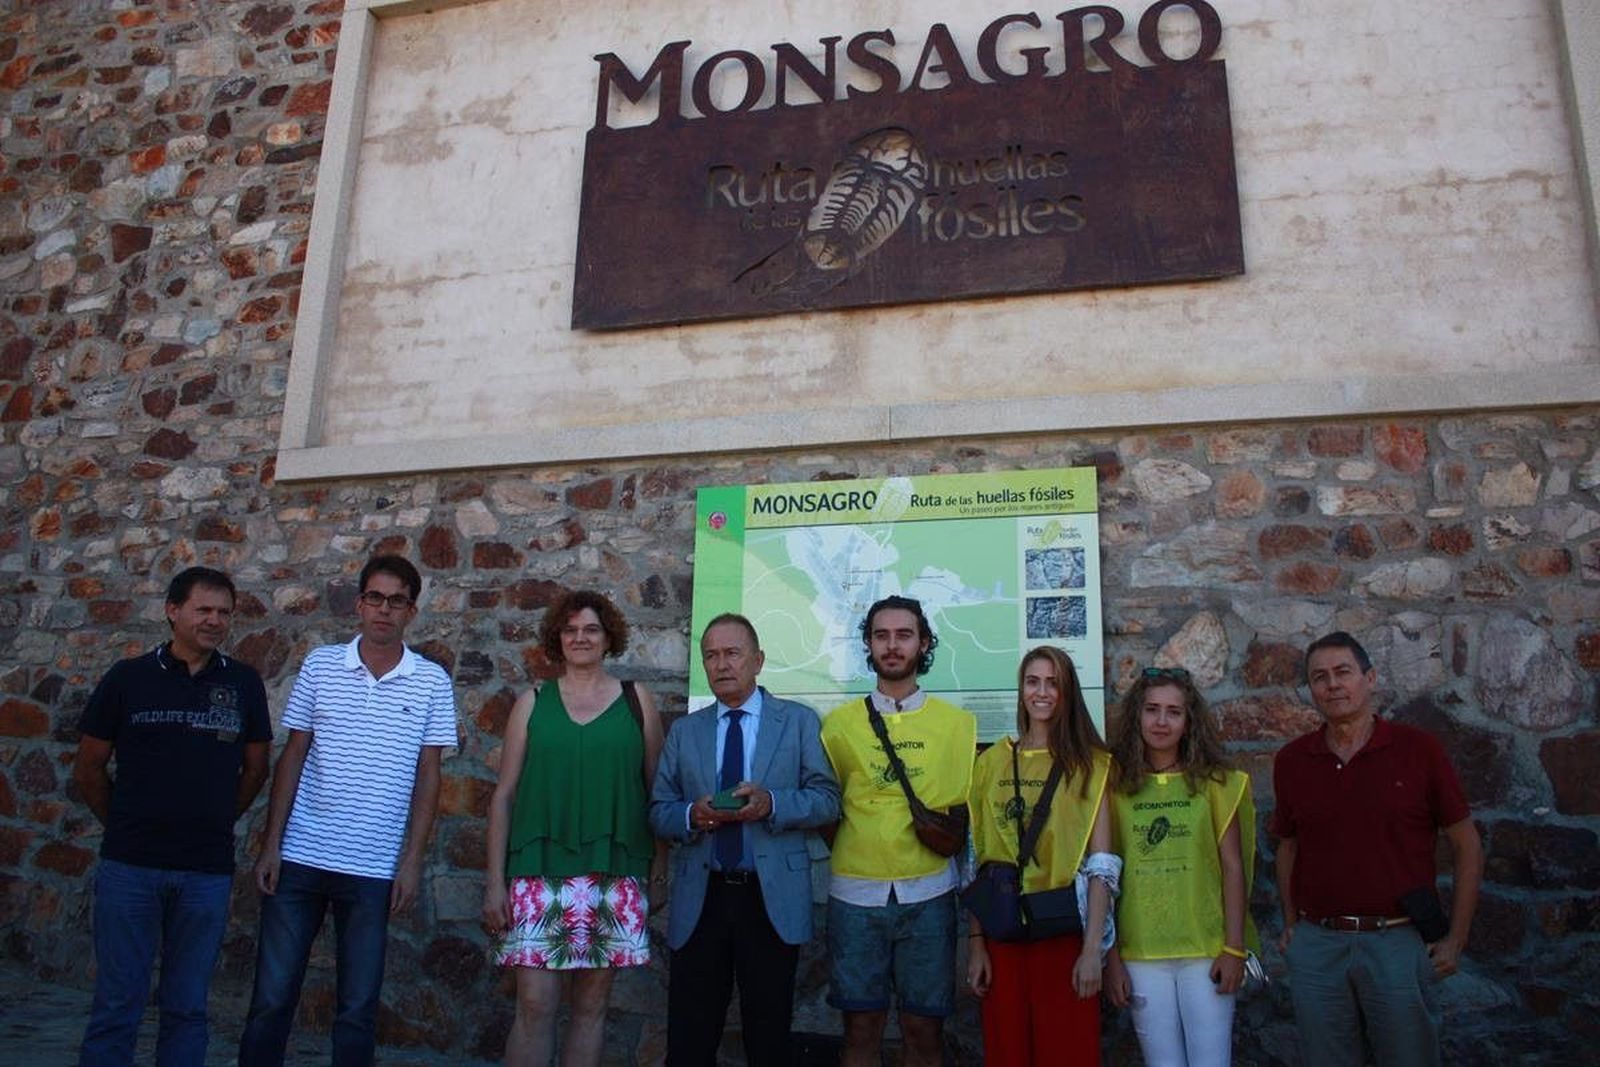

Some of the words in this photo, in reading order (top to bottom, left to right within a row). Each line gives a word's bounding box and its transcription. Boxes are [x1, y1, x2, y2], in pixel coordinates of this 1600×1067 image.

[594, 0, 1222, 129] MONSAGRO
[932, 144, 1069, 188] huellas
[708, 161, 817, 208] Ruta
[752, 490, 877, 515] MONSAGRO
[910, 493, 942, 508] Ruta
[945, 496, 958, 506] de
[959, 495, 974, 506] las
[976, 488, 1026, 504] huellas
[1029, 486, 1075, 502] fósiles
[131, 710, 184, 726] WILDLIFE
